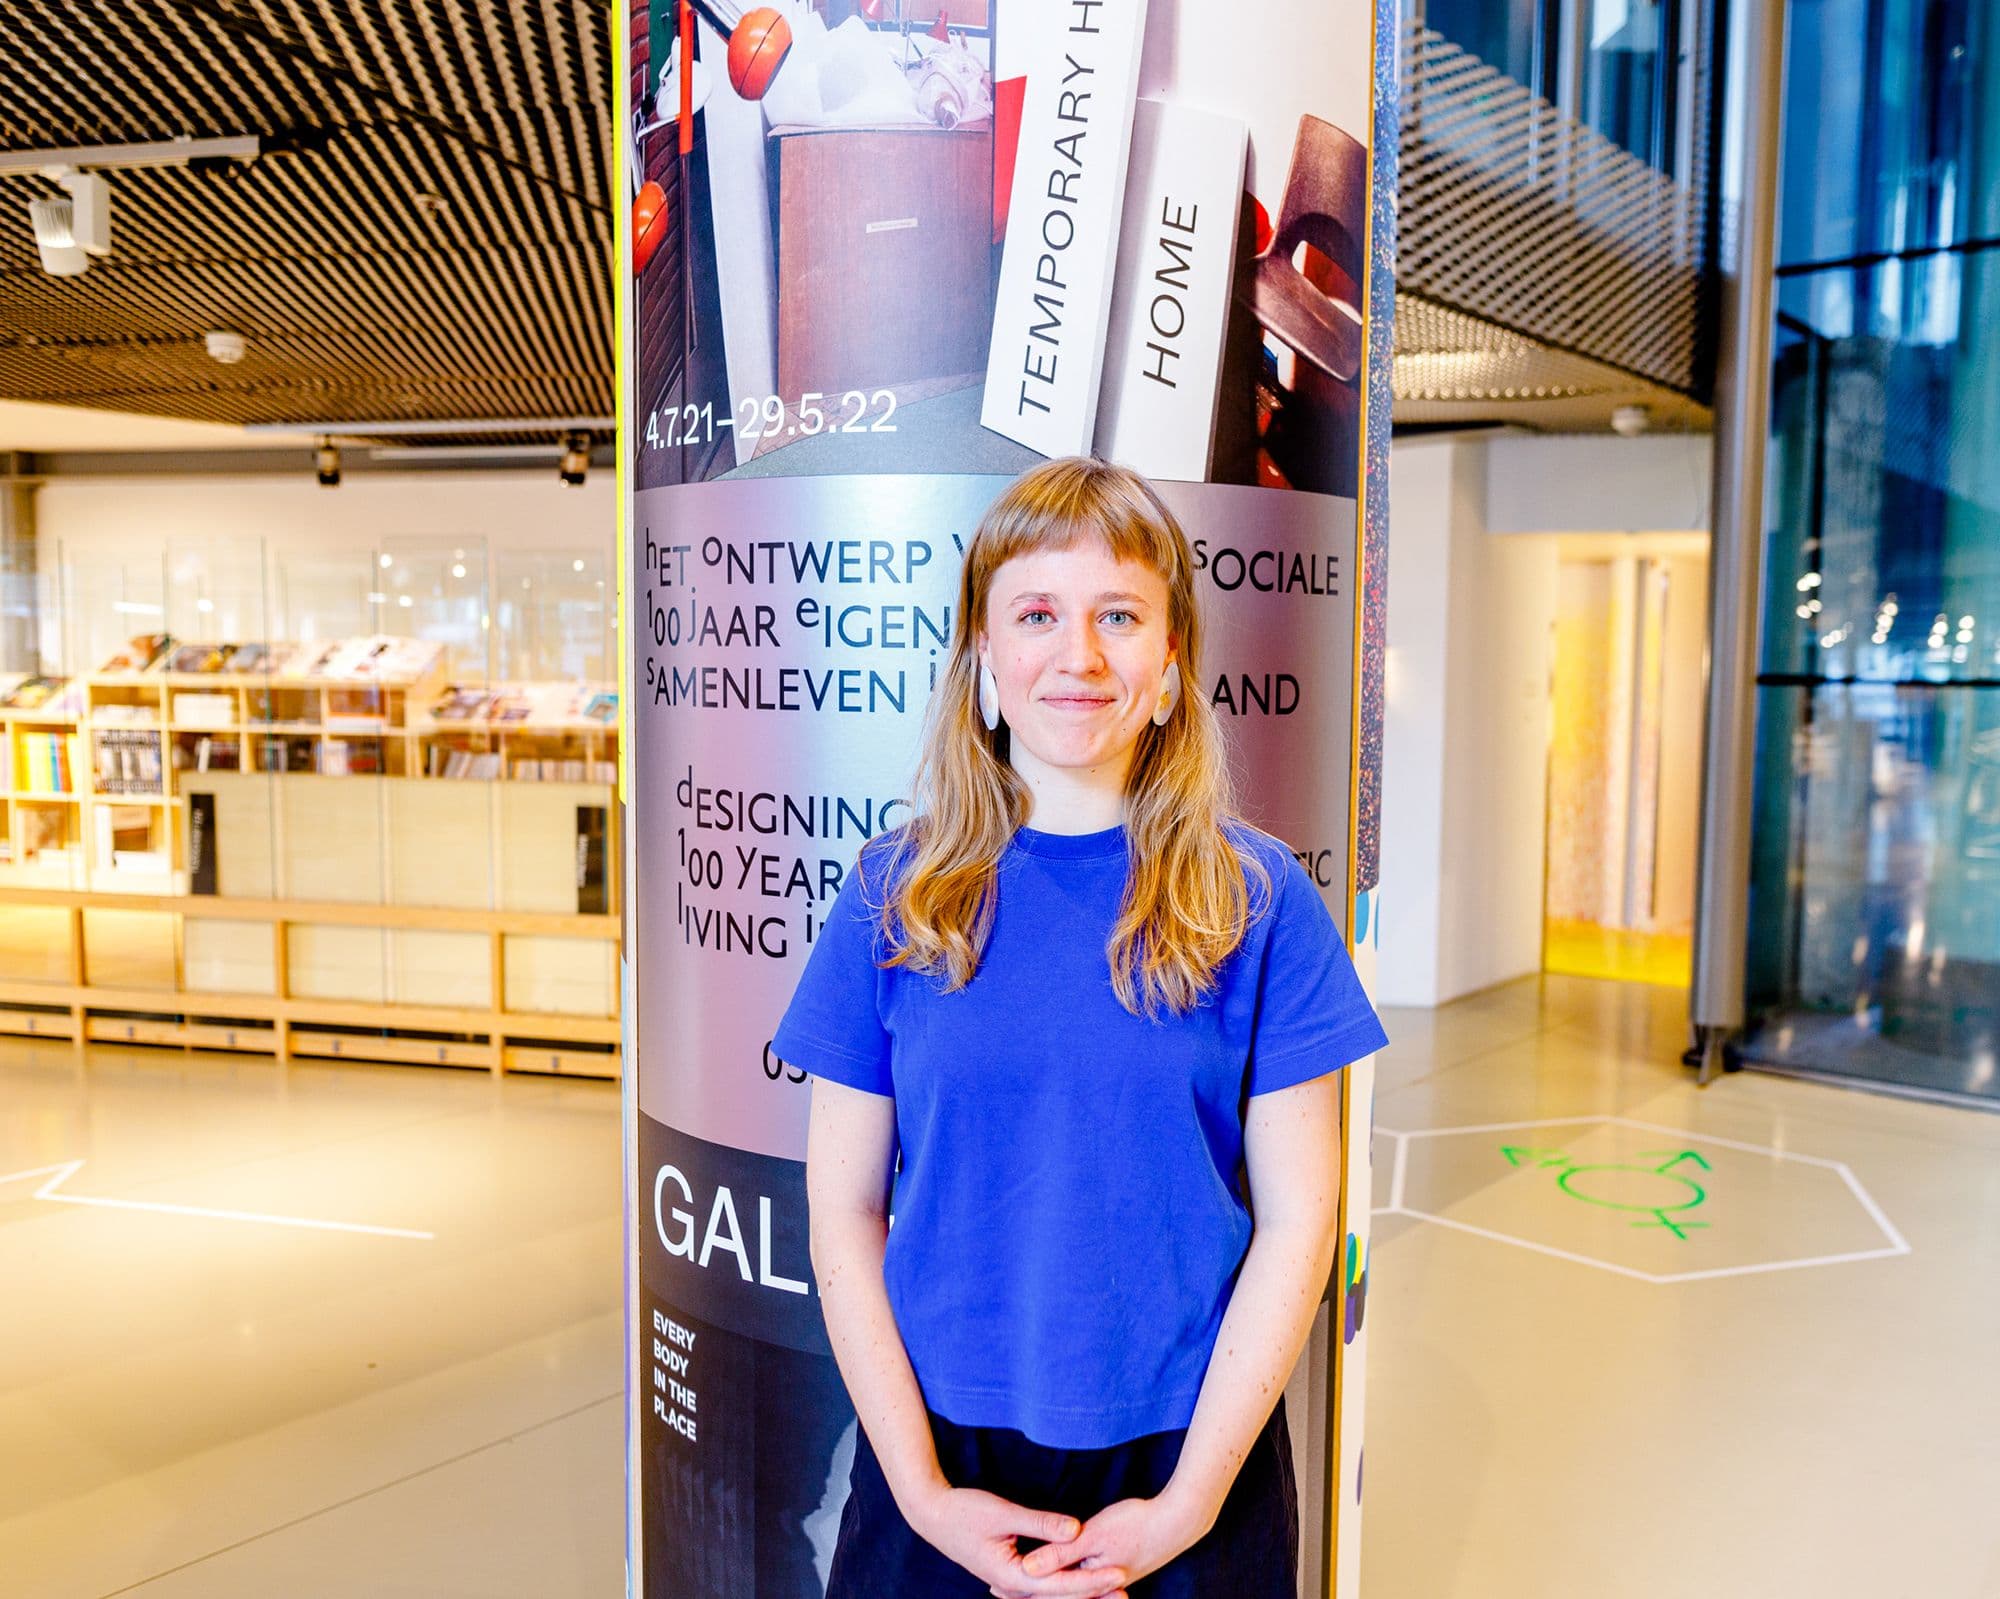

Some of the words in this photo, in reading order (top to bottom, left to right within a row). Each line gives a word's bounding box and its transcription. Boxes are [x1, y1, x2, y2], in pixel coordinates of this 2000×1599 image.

[1018, 53, 1095, 415] TEMPORARY
[1142, 196, 1198, 389] HOME
[678, 828, 723, 890] 100
[654, 1164, 809, 1295] GAL
[653, 1308, 696, 1353] EVERY
[653, 1337, 689, 1379] BODY
[653, 1365, 666, 1393] IN
[668, 1377, 697, 1413] THE
[653, 1394, 697, 1443] PLACE
